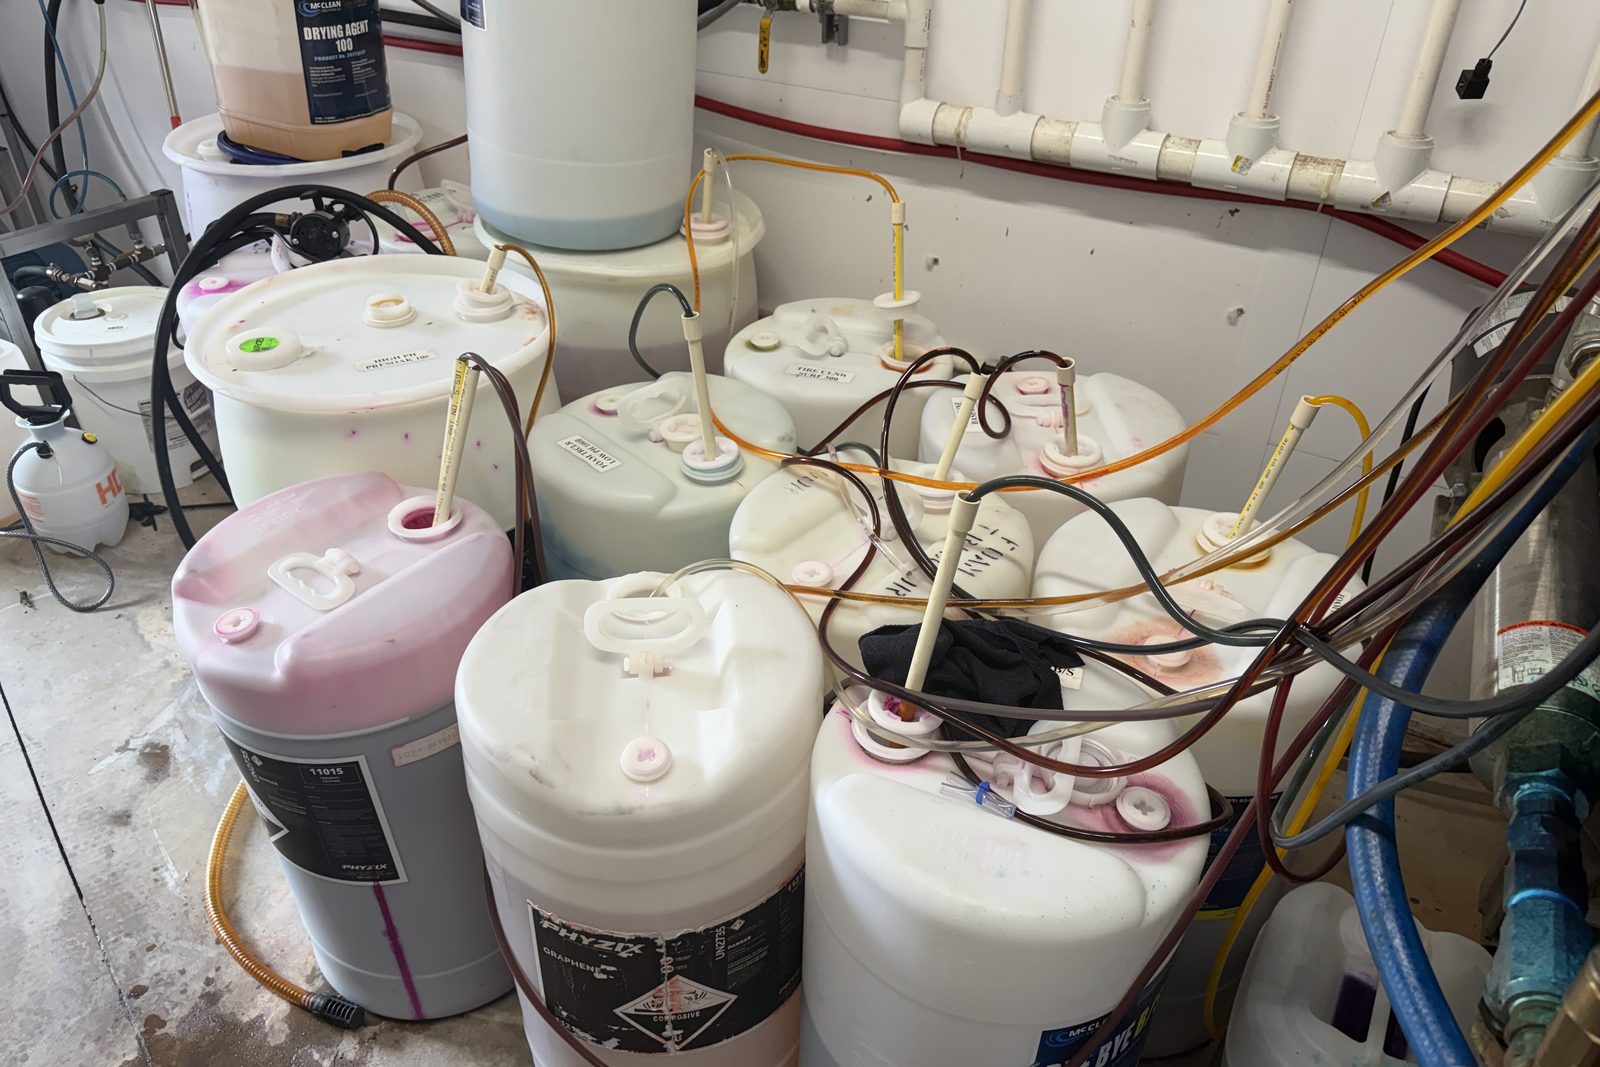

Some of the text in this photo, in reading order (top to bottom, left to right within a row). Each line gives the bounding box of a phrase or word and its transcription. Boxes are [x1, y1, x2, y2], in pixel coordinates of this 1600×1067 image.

[303, 20, 369, 40] DRYING AGENT
[335, 38, 354, 53] 100
[586, 453, 608, 468] FOAM
[599, 453, 617, 464] LOW
[310, 767, 344, 776] 11015
[541, 920, 646, 955] PHYZIX
[715, 925, 726, 961] UN2735
